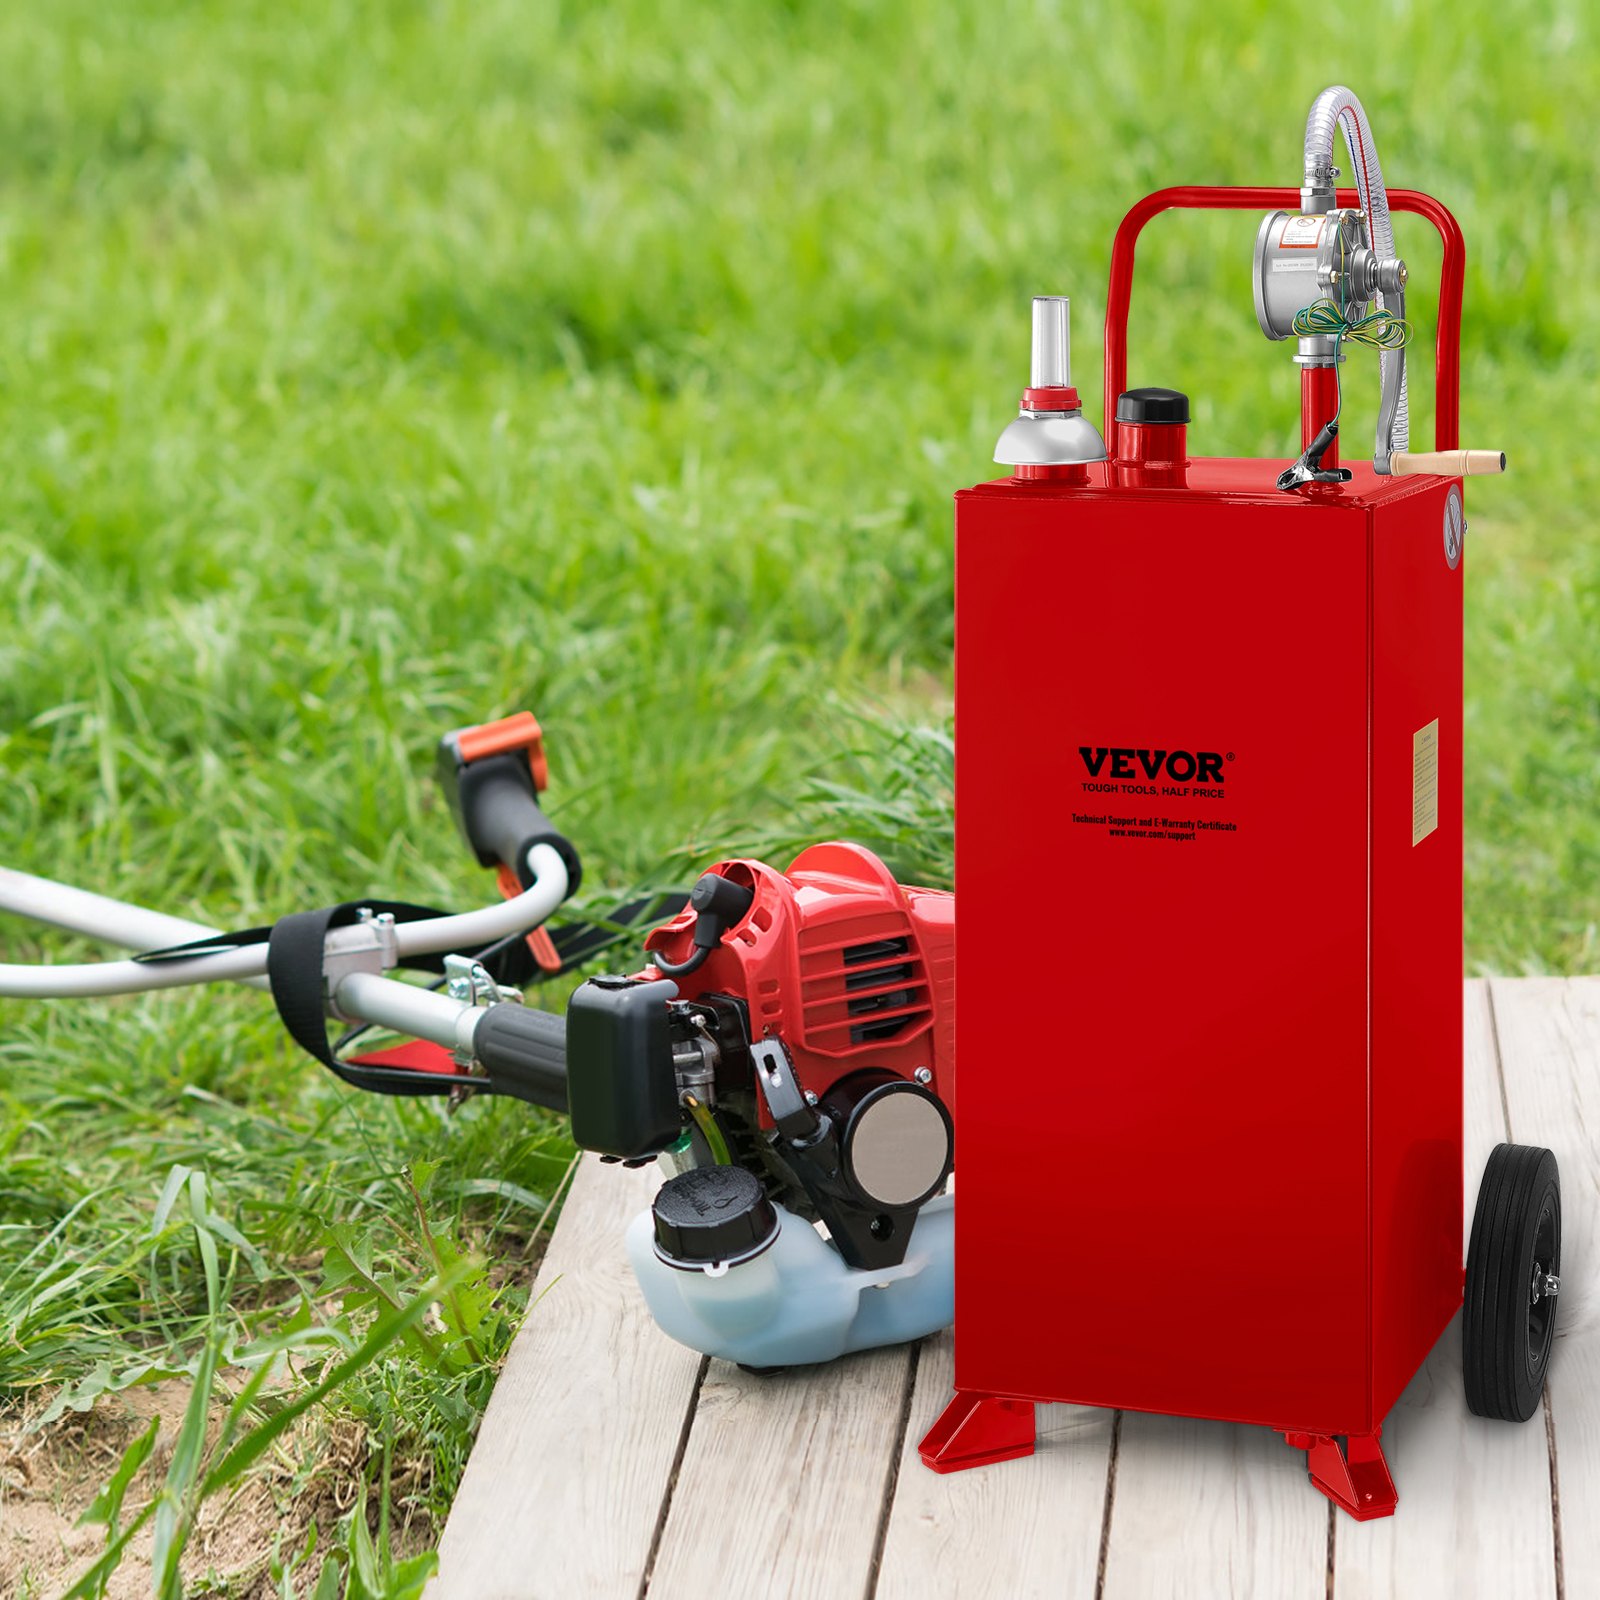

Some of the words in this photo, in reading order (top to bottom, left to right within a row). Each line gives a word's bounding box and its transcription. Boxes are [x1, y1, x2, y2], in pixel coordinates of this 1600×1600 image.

[1081, 783, 1118, 793] TOUGH
[1121, 784, 1159, 796] TOOLS,
[1162, 786, 1189, 797] HALF
[1193, 788, 1225, 799] PRICE
[1072, 813, 1106, 824] Technical
[1108, 815, 1137, 827] Support
[1139, 817, 1152, 827] and
[1154, 817, 1195, 831] E-Warranty
[1197, 820, 1237, 832] Certificate
[1109, 828, 1196, 842] www.vevor.com/support
